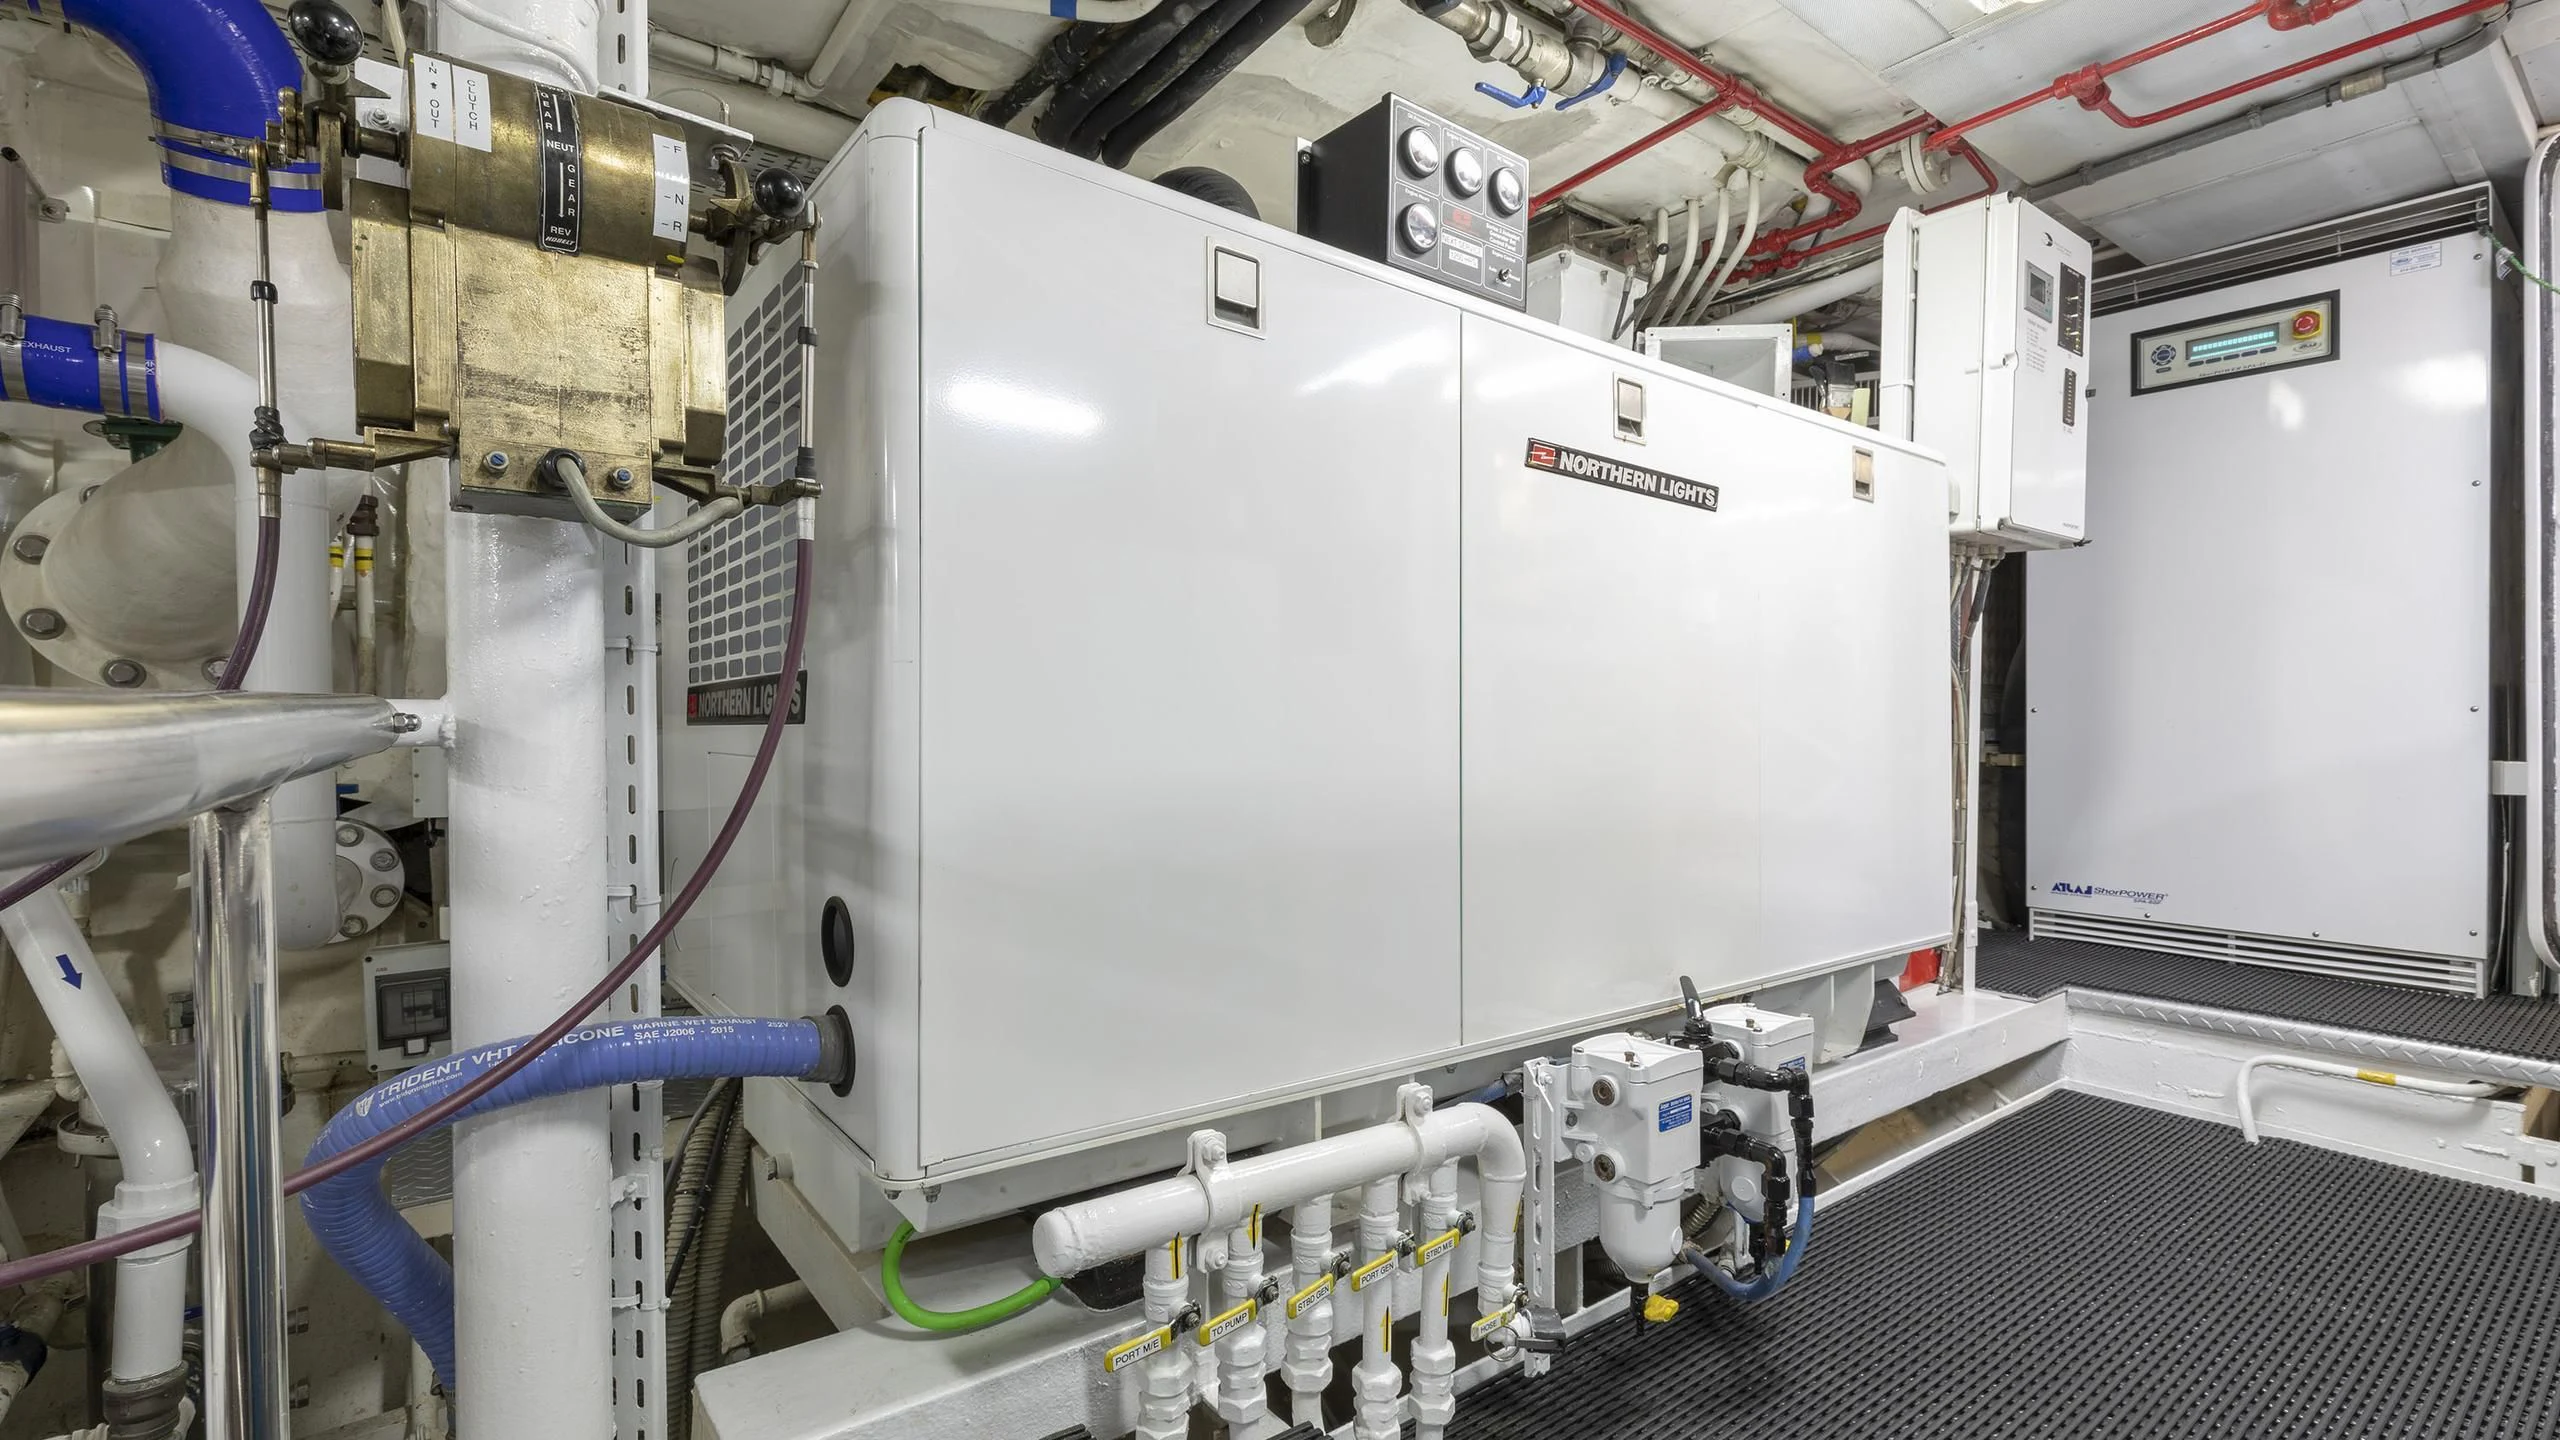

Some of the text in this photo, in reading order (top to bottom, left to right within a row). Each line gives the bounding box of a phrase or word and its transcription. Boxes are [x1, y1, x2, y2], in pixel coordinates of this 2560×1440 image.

[428, 61, 440, 129] IN OUT
[466, 79, 479, 131] CLUTCH
[540, 92, 553, 131] GEAR
[546, 138, 576, 153] NEUT
[567, 164, 576, 217] GEAR
[550, 225, 572, 236] REV
[22, 340, 73, 354] EXHAUST
[1559, 451, 1717, 507] NORTHERN LIGHTS
[699, 681, 802, 717] NORTHERN LIGS
[631, 1017, 758, 1031] MARINE WET EXHAUST
[633, 1029, 661, 1041] SAE
[662, 1027, 696, 1038] J2006
[710, 1025, 735, 1034] 2015
[378, 1057, 466, 1100] TRIDENT
[472, 1044, 518, 1065] VHT
[378, 1071, 463, 1109] www.tridentmarine.com
[1425, 1247, 1442, 1260] STBD
[1361, 1261, 1395, 1285] PORT GEN
[1296, 1285, 1330, 1312] STBD GEN
[1211, 1312, 1249, 1338] TO PUMP
[1480, 1320, 1498, 1334] HOSE
[1115, 1338, 1160, 1368] PORT M/E
